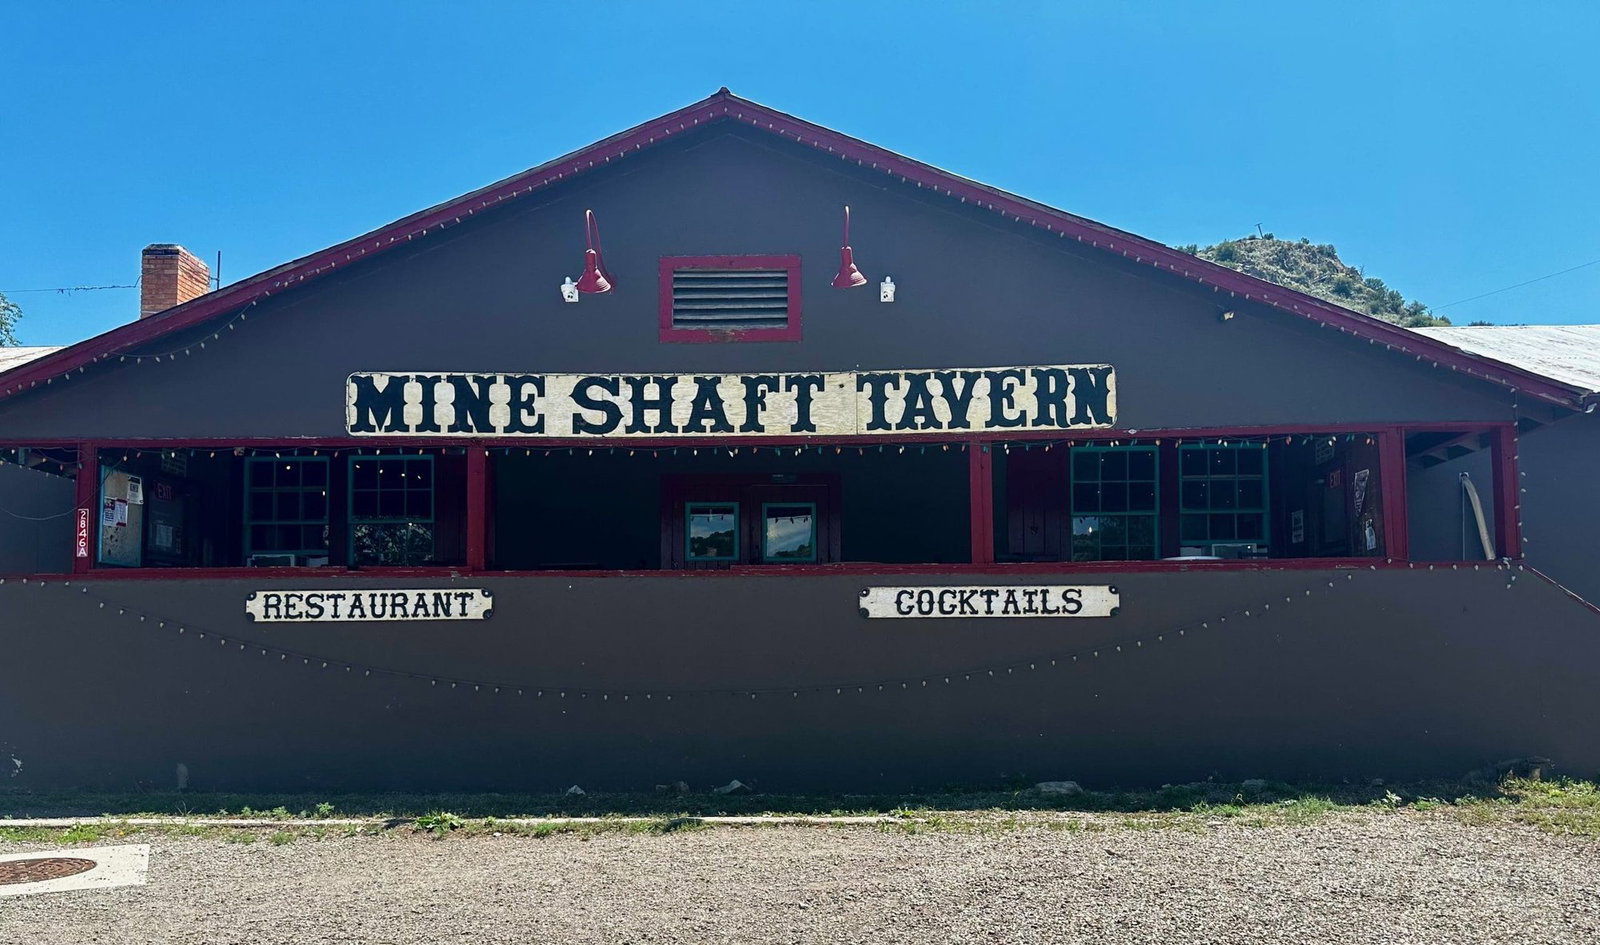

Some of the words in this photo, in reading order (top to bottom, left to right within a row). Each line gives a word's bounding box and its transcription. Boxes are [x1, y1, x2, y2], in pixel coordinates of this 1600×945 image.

[350, 375, 545, 433] MINE
[569, 374, 825, 434] SHAFT
[856, 367, 1114, 431] TAVERN
[78, 510, 88, 556] 2846A
[263, 592, 474, 620] RESTAURANT
[894, 588, 1083, 616] COCKTAILS
